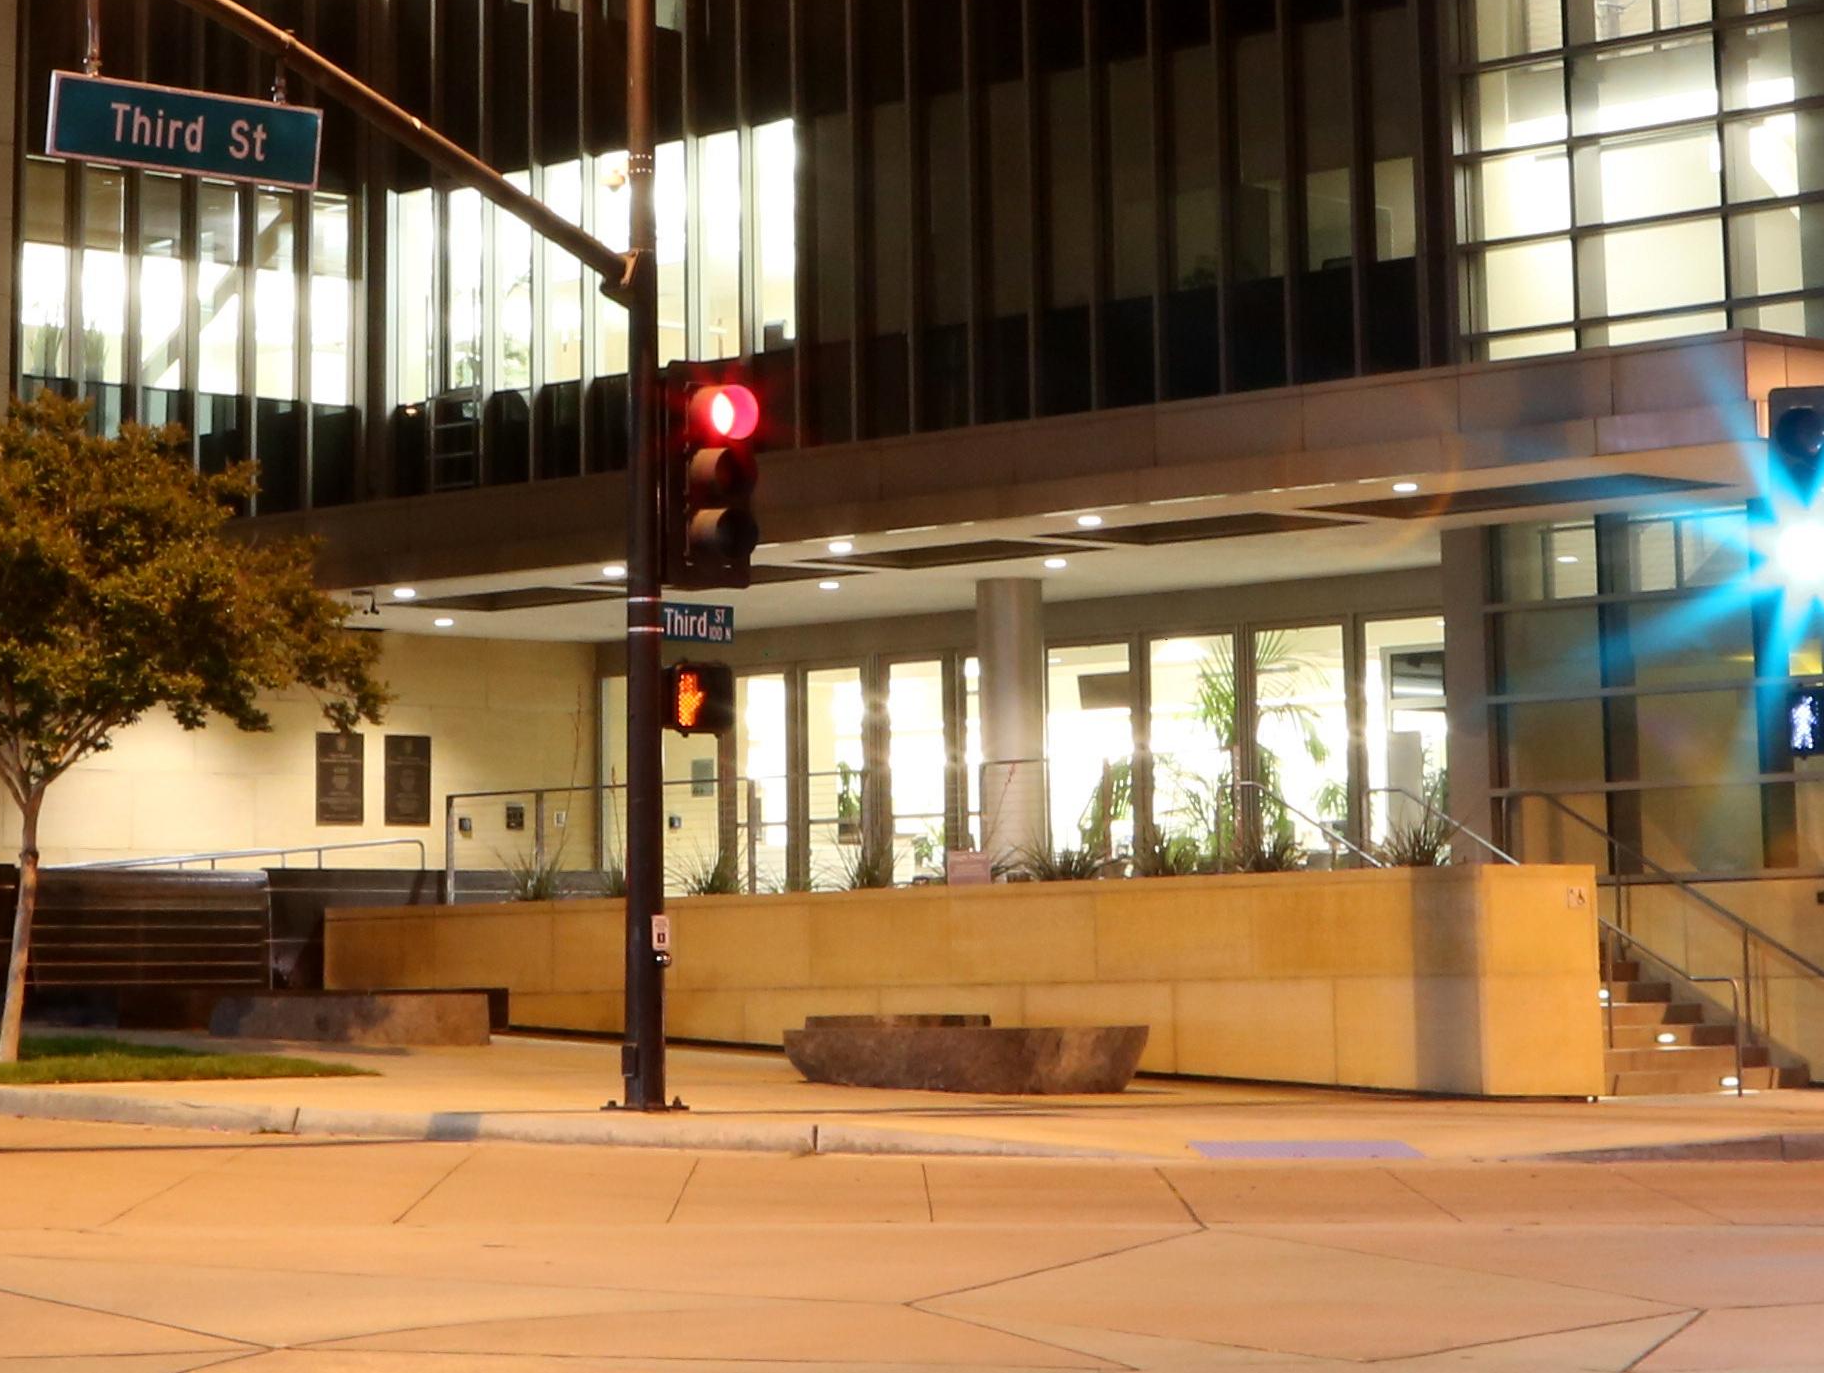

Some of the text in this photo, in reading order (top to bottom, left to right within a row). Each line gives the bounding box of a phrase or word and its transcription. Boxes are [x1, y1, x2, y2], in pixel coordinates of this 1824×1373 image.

[111, 102, 267, 161] Third St
[664, 607, 725, 638] Third ST
[708, 626, 732, 641] 100 N
